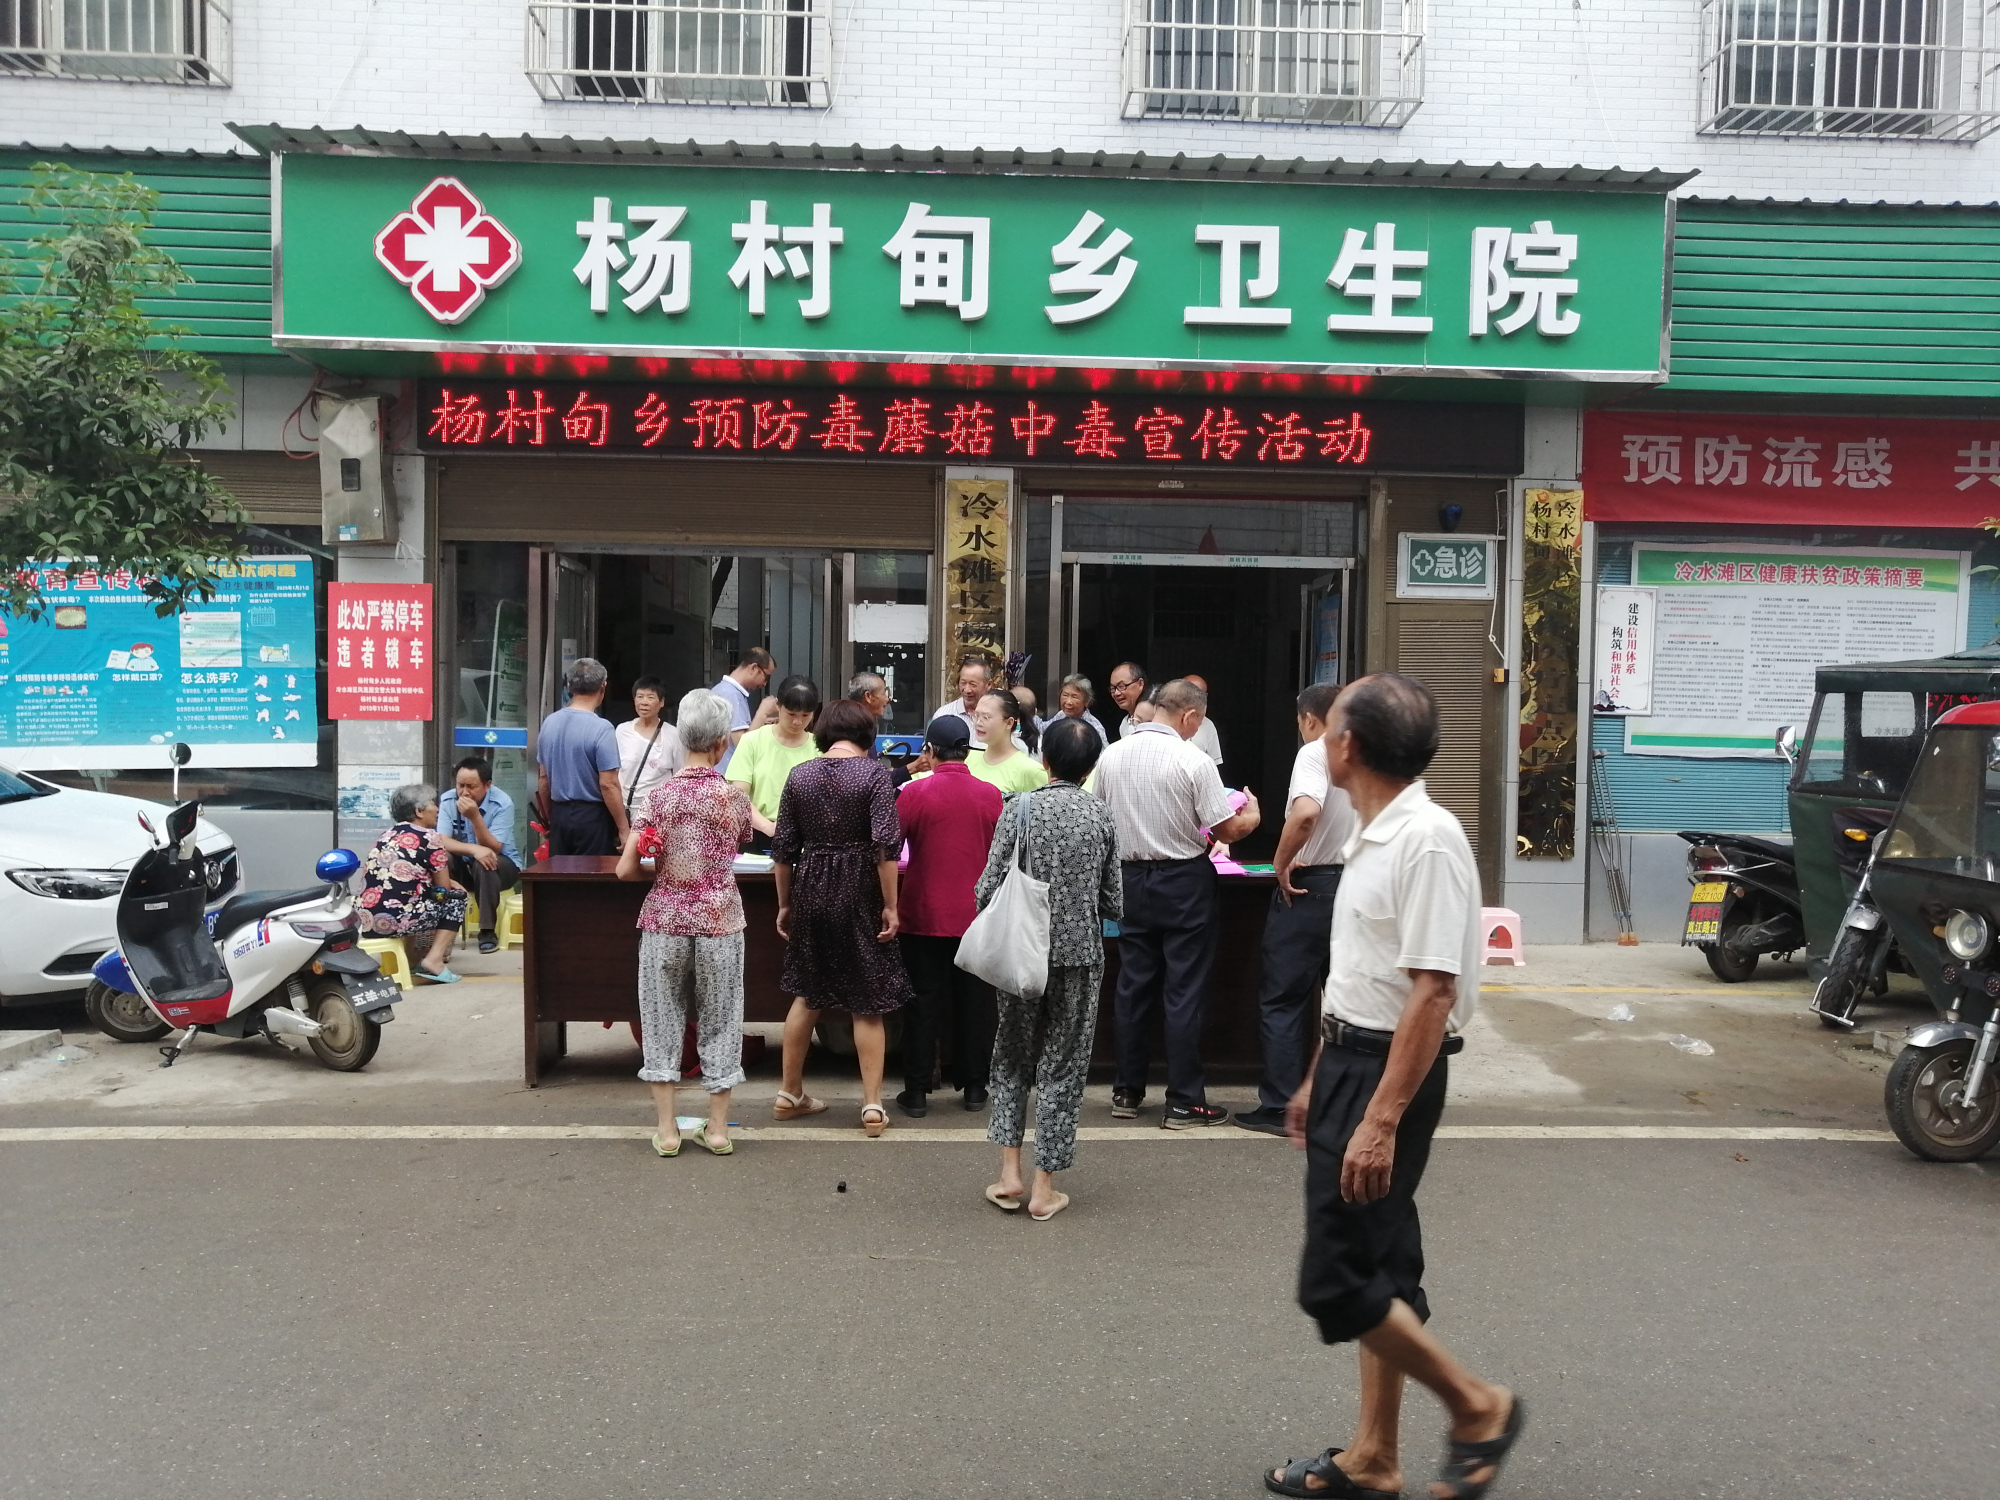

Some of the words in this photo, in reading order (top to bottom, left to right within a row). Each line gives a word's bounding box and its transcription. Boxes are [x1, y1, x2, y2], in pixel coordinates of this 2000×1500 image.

[573, 197, 1582, 337] 杨村甸乡卫生院
[428, 388, 1372, 464] 杨村甸乡预防毒蘑菇中毒宣传活动
[1620, 434, 1893, 489] 预防流感
[1433, 545, 1484, 580] 急诊
[1674, 562, 1926, 588] 冷水滩区健康扶贫政策摘要
[337, 599, 424, 632] 此处严禁停车
[337, 637, 424, 669] 违者锁车
[1625, 602, 1639, 675] 建设信用体系
[180, 672, 239, 684] 怎么洗手?
[1610, 626, 1623, 699] 构筑和谐社会
